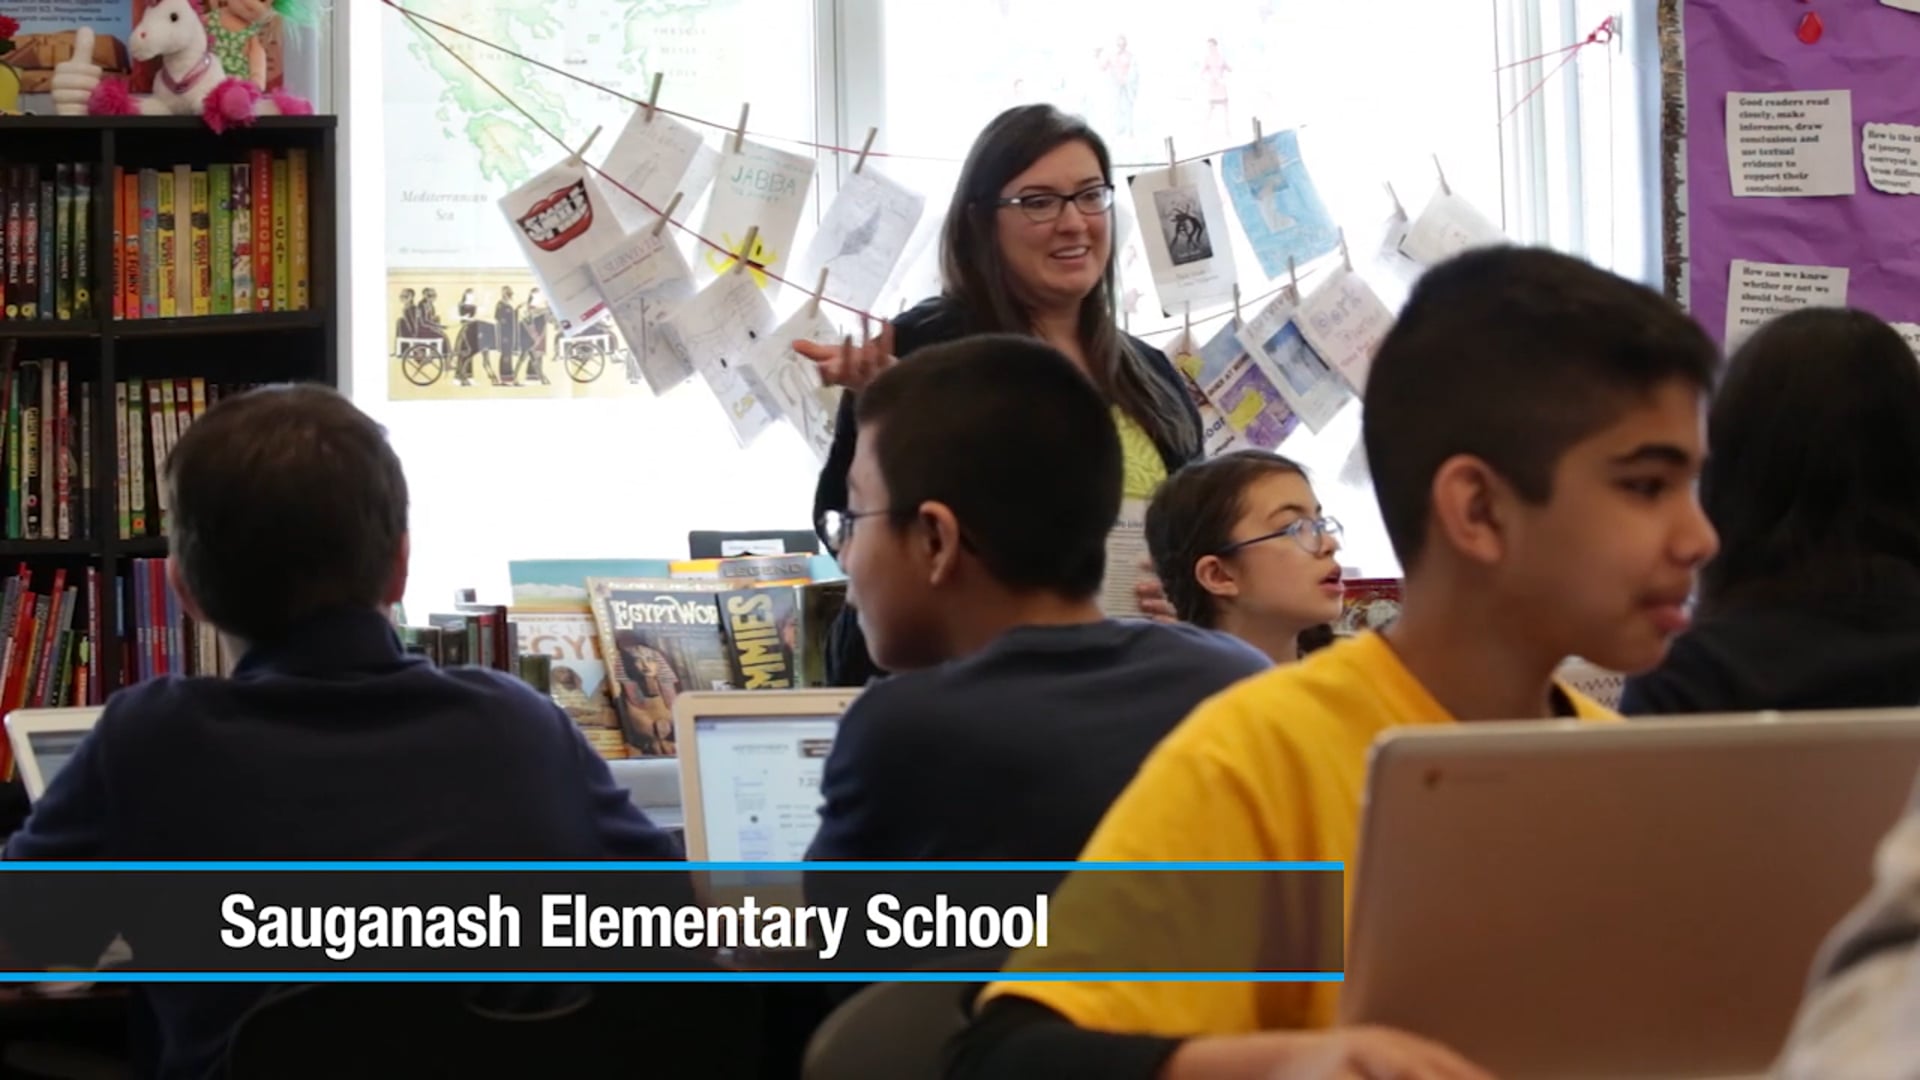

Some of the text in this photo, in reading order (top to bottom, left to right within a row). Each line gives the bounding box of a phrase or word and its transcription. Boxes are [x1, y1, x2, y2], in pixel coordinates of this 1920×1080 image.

[1739, 98, 1762, 106] Good
[1765, 98, 1803, 106] readers
[1740, 135, 1819, 143] conclusions and
[1759, 147, 1795, 155] textual
[1742, 160, 1783, 168] evidence
[731, 165, 796, 196] JABBA
[1744, 172, 1809, 181] support their
[400, 190, 488, 203] Mediterranean
[434, 208, 455, 221] Sea
[259, 205, 271, 266] CHOMP
[275, 216, 285, 265] SCAT
[1743, 266, 1762, 276] How
[1800, 271, 1829, 280] know
[1743, 280, 1780, 290] whether
[611, 595, 720, 630] EGYPTWOR
[727, 593, 790, 690] MMIES
